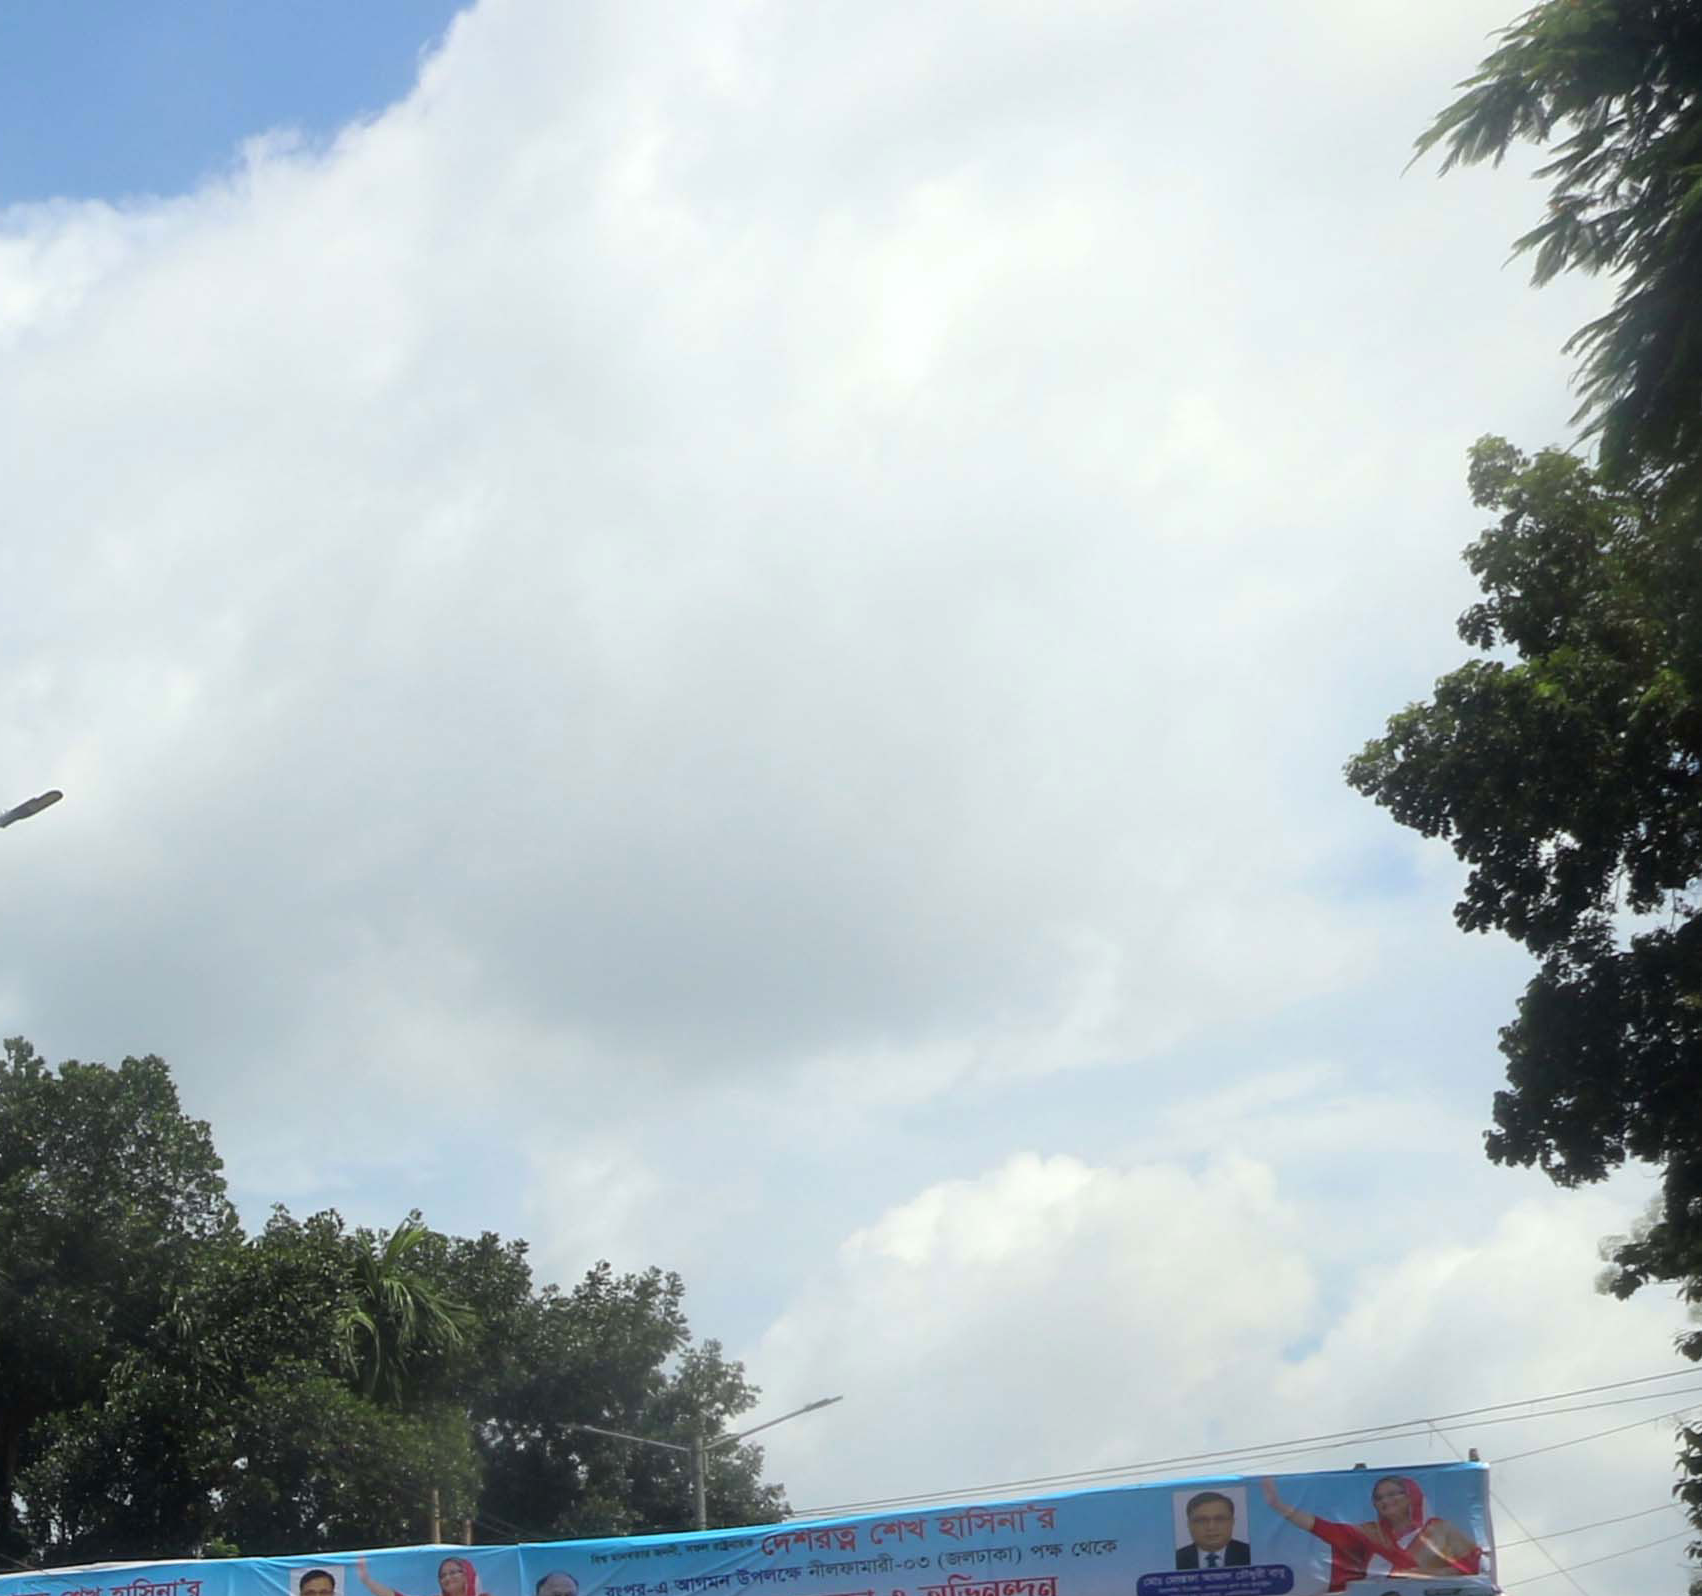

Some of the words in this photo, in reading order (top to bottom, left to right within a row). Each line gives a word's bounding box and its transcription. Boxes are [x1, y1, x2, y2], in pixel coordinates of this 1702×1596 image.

[762, 1526, 858, 1555] দেশরত্ন
[871, 1518, 927, 1544] শেখ
[935, 1504, 1057, 1540] হাসিনা'র
[675, 1576, 731, 1592] আগমন
[737, 1566, 801, 1586] উপলক্ষে
[1030, 1542, 1064, 1558] পক্ষ
[1071, 1538, 1118, 1557] থেকে
